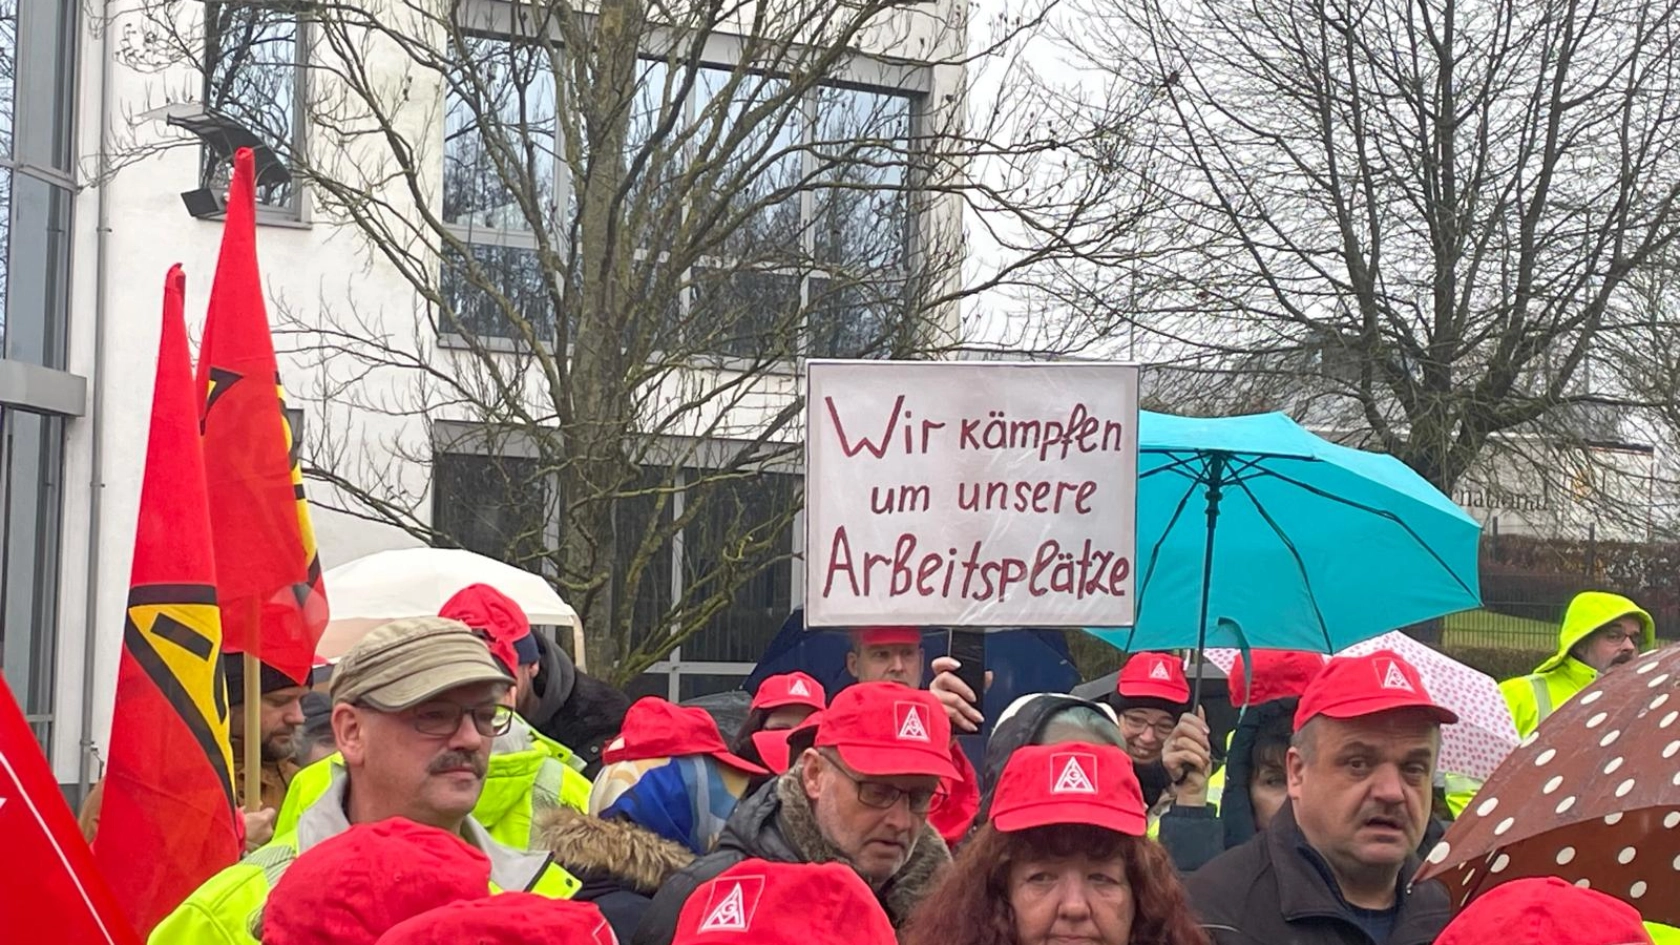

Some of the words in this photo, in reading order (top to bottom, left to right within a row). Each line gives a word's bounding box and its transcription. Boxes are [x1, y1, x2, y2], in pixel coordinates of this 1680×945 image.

[824, 394, 946, 459] Wir
[959, 403, 1122, 461] kämpfen
[870, 485, 930, 514] um
[958, 481, 1097, 514] unsere
